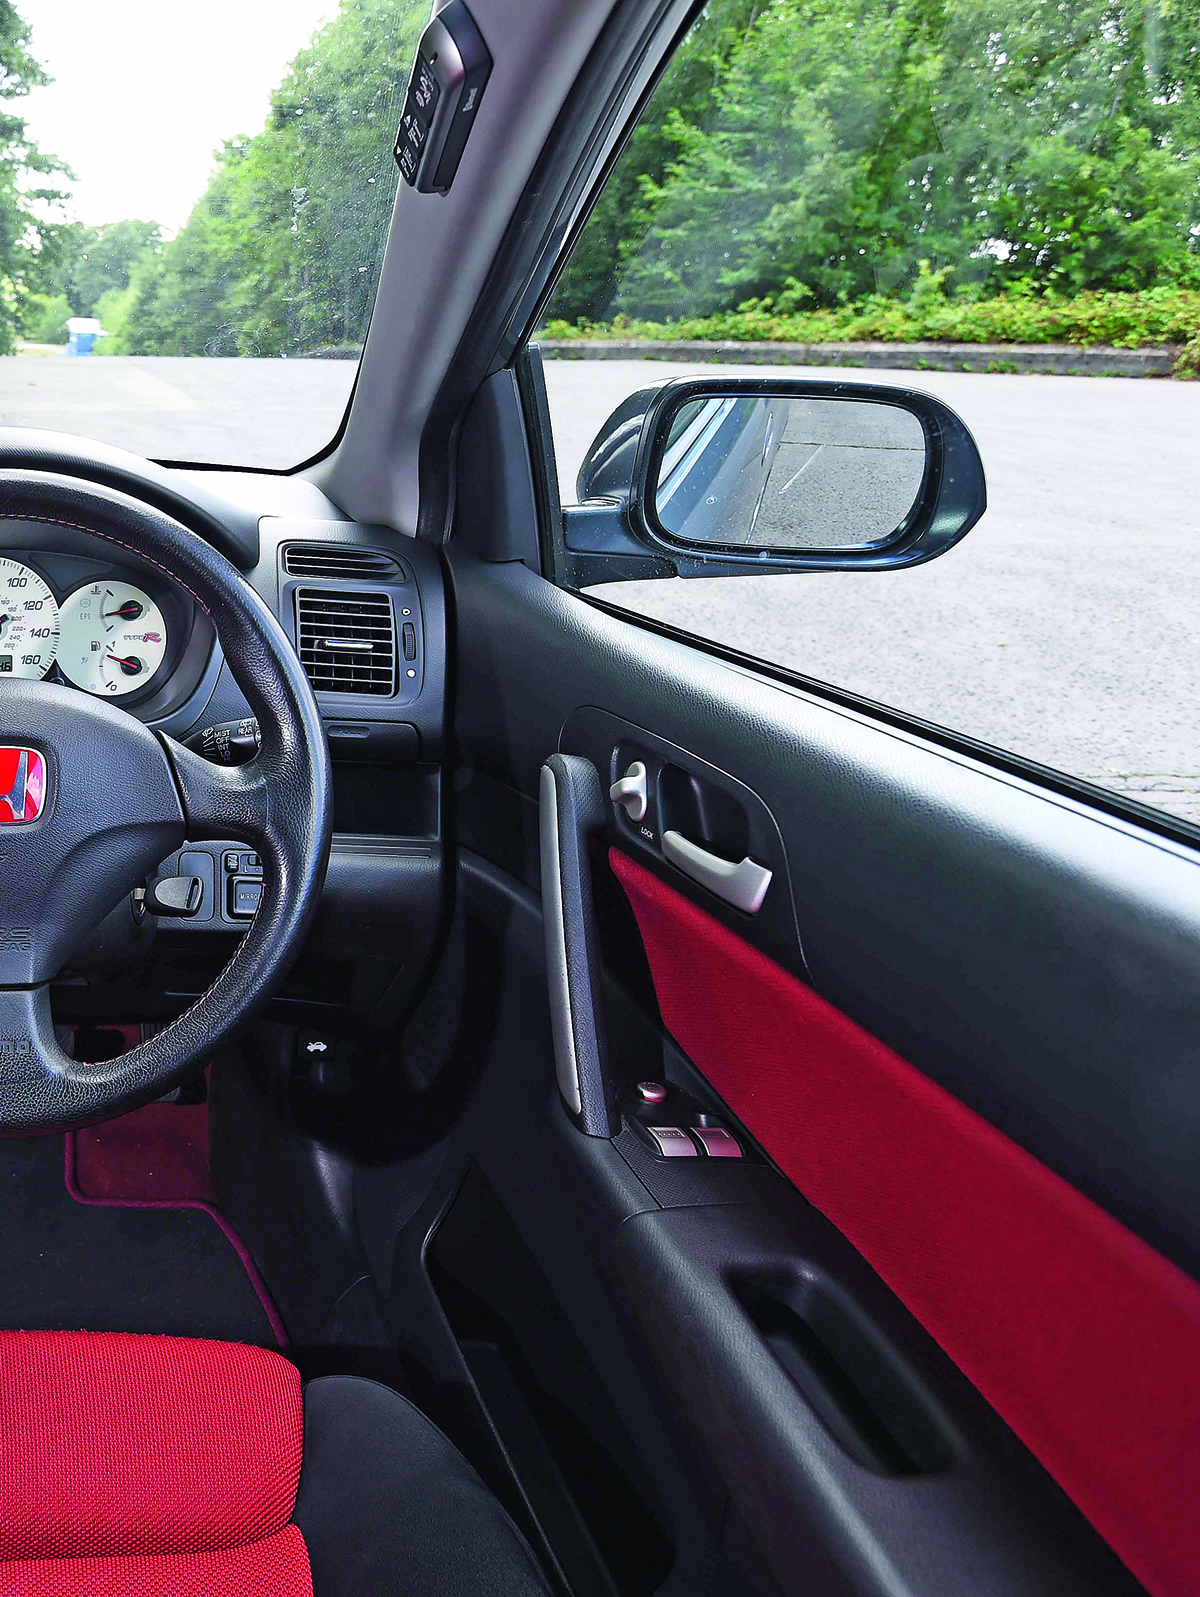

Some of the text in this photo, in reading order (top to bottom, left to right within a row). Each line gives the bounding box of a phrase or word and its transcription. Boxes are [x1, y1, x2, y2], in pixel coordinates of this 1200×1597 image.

[7, 578, 27, 587] 100
[22, 600, 43, 610] 120
[29, 628, 50, 638] 140
[21, 655, 41, 664] 160
